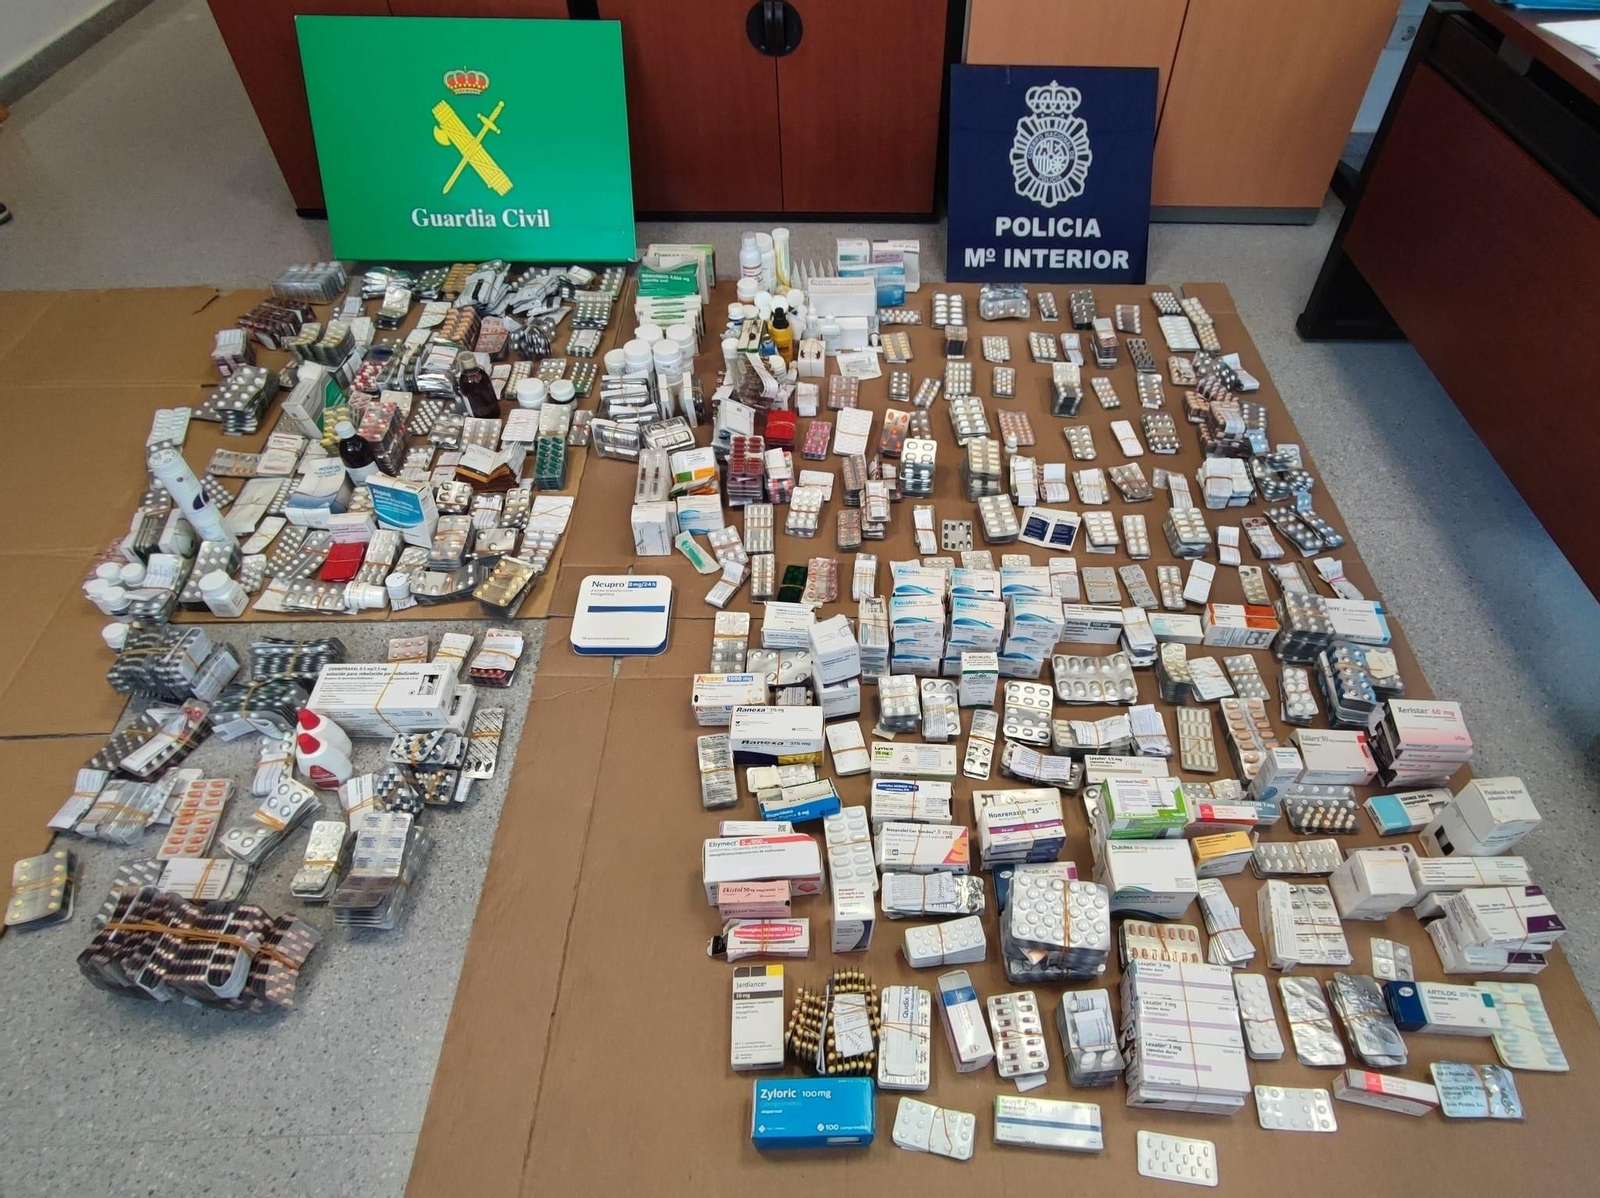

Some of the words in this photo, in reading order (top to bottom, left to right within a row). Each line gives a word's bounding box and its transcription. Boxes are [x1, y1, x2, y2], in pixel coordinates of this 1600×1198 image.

[1045, 132, 1072, 150] NACIONAL
[411, 208, 497, 228] Guardia
[502, 208, 551, 228] Civil
[995, 217, 1101, 238] POLICIA
[964, 247, 996, 268] Mº
[1004, 248, 1130, 270] INTERIOR
[592, 581, 625, 589] Neupro
[1427, 988, 1457, 997] ARTILOG
[760, 1089, 797, 1100] Zyloric
